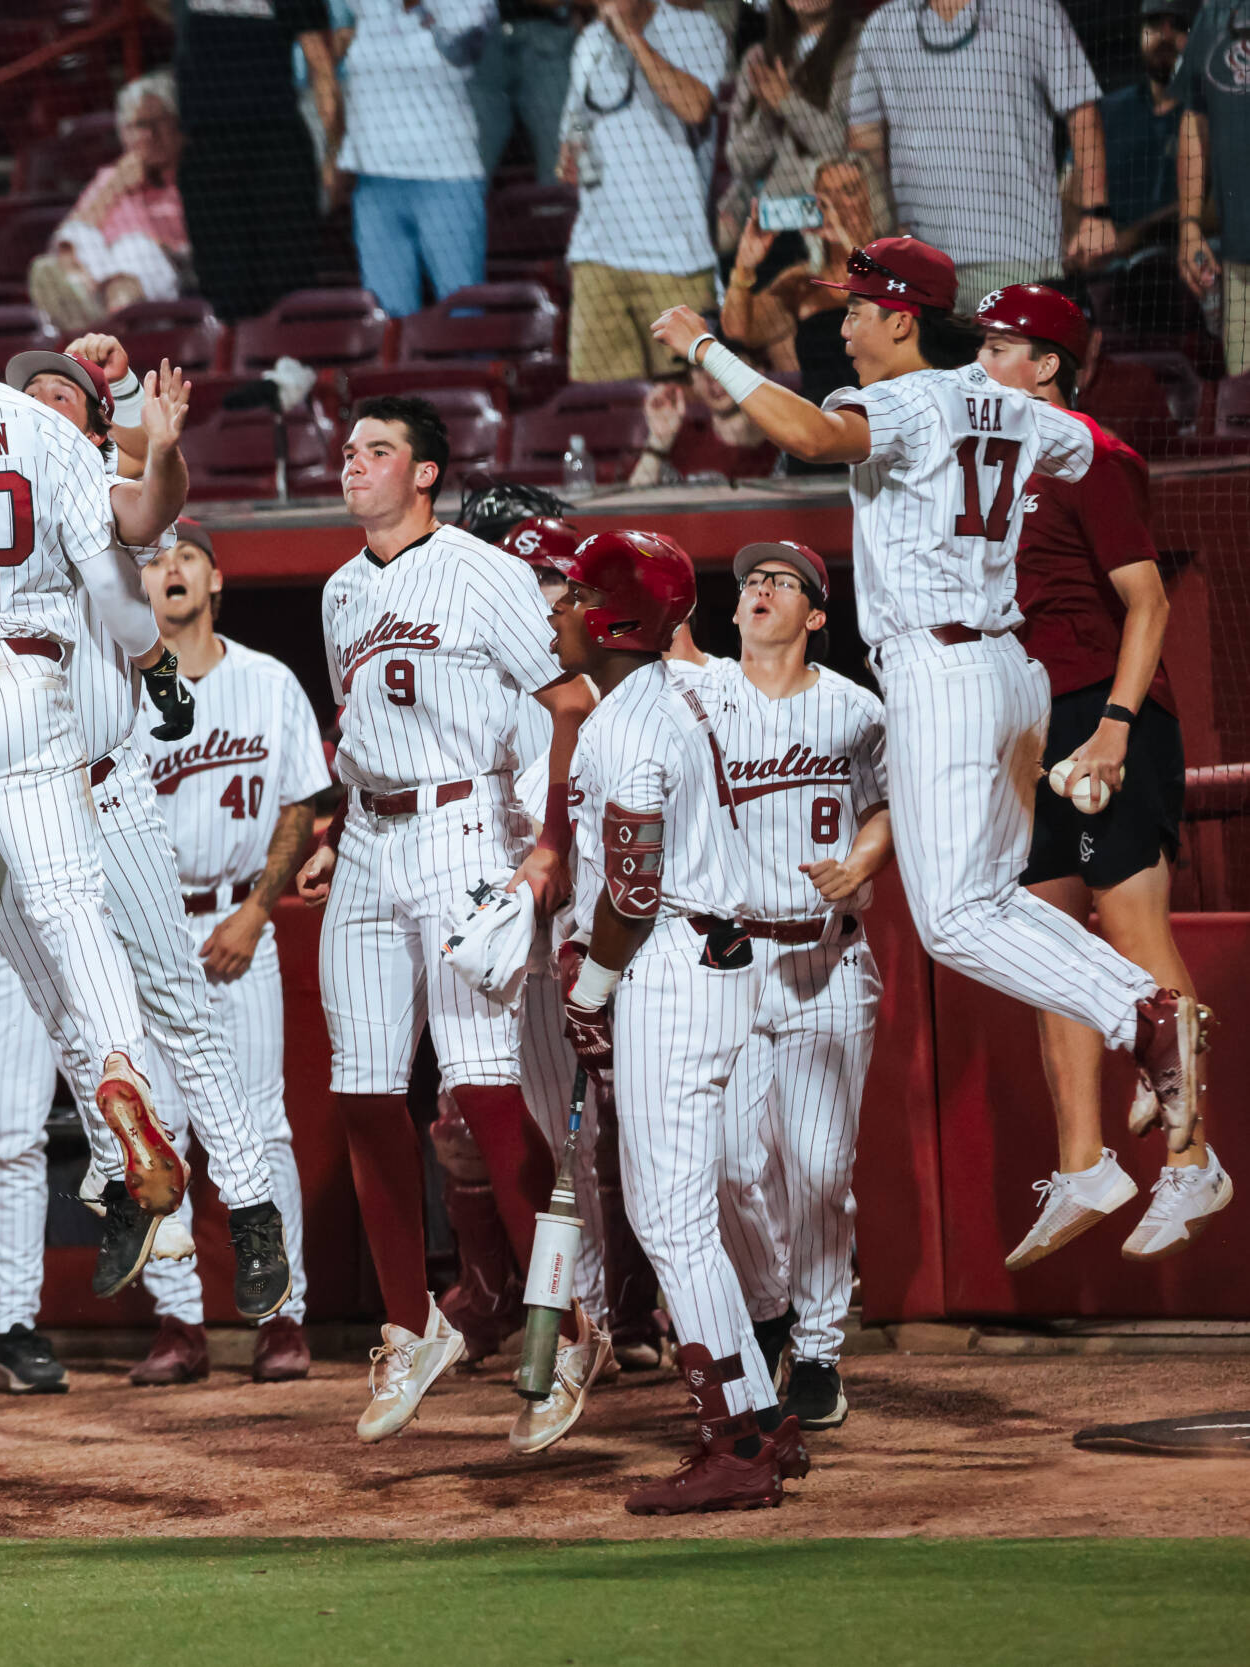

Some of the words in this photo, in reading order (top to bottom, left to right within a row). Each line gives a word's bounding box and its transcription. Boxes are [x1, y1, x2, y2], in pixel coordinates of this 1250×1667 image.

[954, 435, 1023, 543] 17
[385, 659, 417, 707] 9
[145, 727, 266, 780] arolina
[727, 742, 851, 781] arolina
[219, 774, 265, 820] 40
[811, 796, 842, 845] 8
